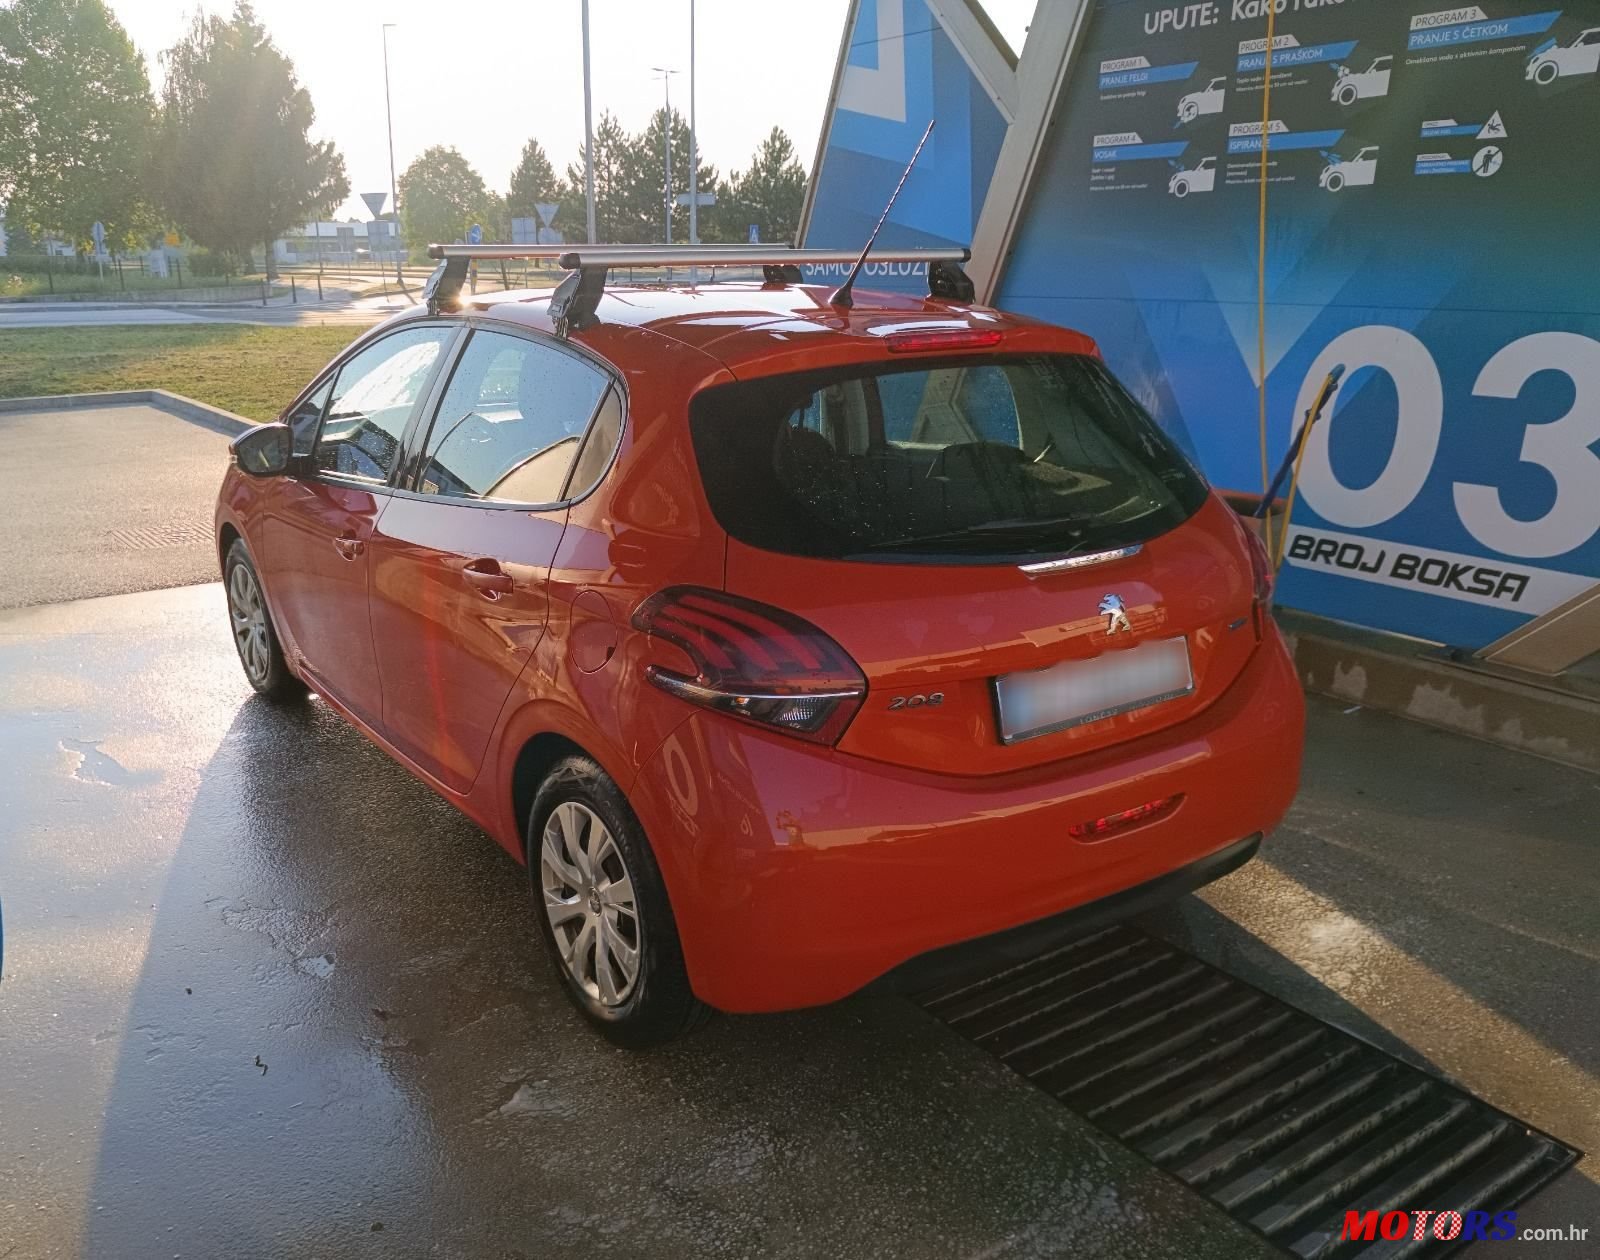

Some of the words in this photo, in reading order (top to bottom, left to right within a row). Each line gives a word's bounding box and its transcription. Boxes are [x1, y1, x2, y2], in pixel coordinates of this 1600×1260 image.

[1143, 2, 1219, 35] UPUTE:
[1415, 10, 1467, 27] PROGRAM
[1470, 9, 1477, 19] 3
[1283, 36, 1290, 46] 2
[1410, 31, 1451, 46] PRANJE
[1453, 30, 1460, 40] S
[1462, 23, 1509, 39] ČETKOM
[1102, 59, 1137, 71] PROGRAM
[1239, 56, 1270, 69] PRANJ
[1279, 48, 1323, 64] PRAŠKOM
[1096, 133, 1130, 145] PROGRAM
[1230, 138, 1270, 150] ISPIRANE
[1290, 324, 1600, 558] 03
[1287, 533, 1386, 574] BROJ
[1389, 553, 1531, 602] BOKSA
[888, 692, 945, 711] 208
